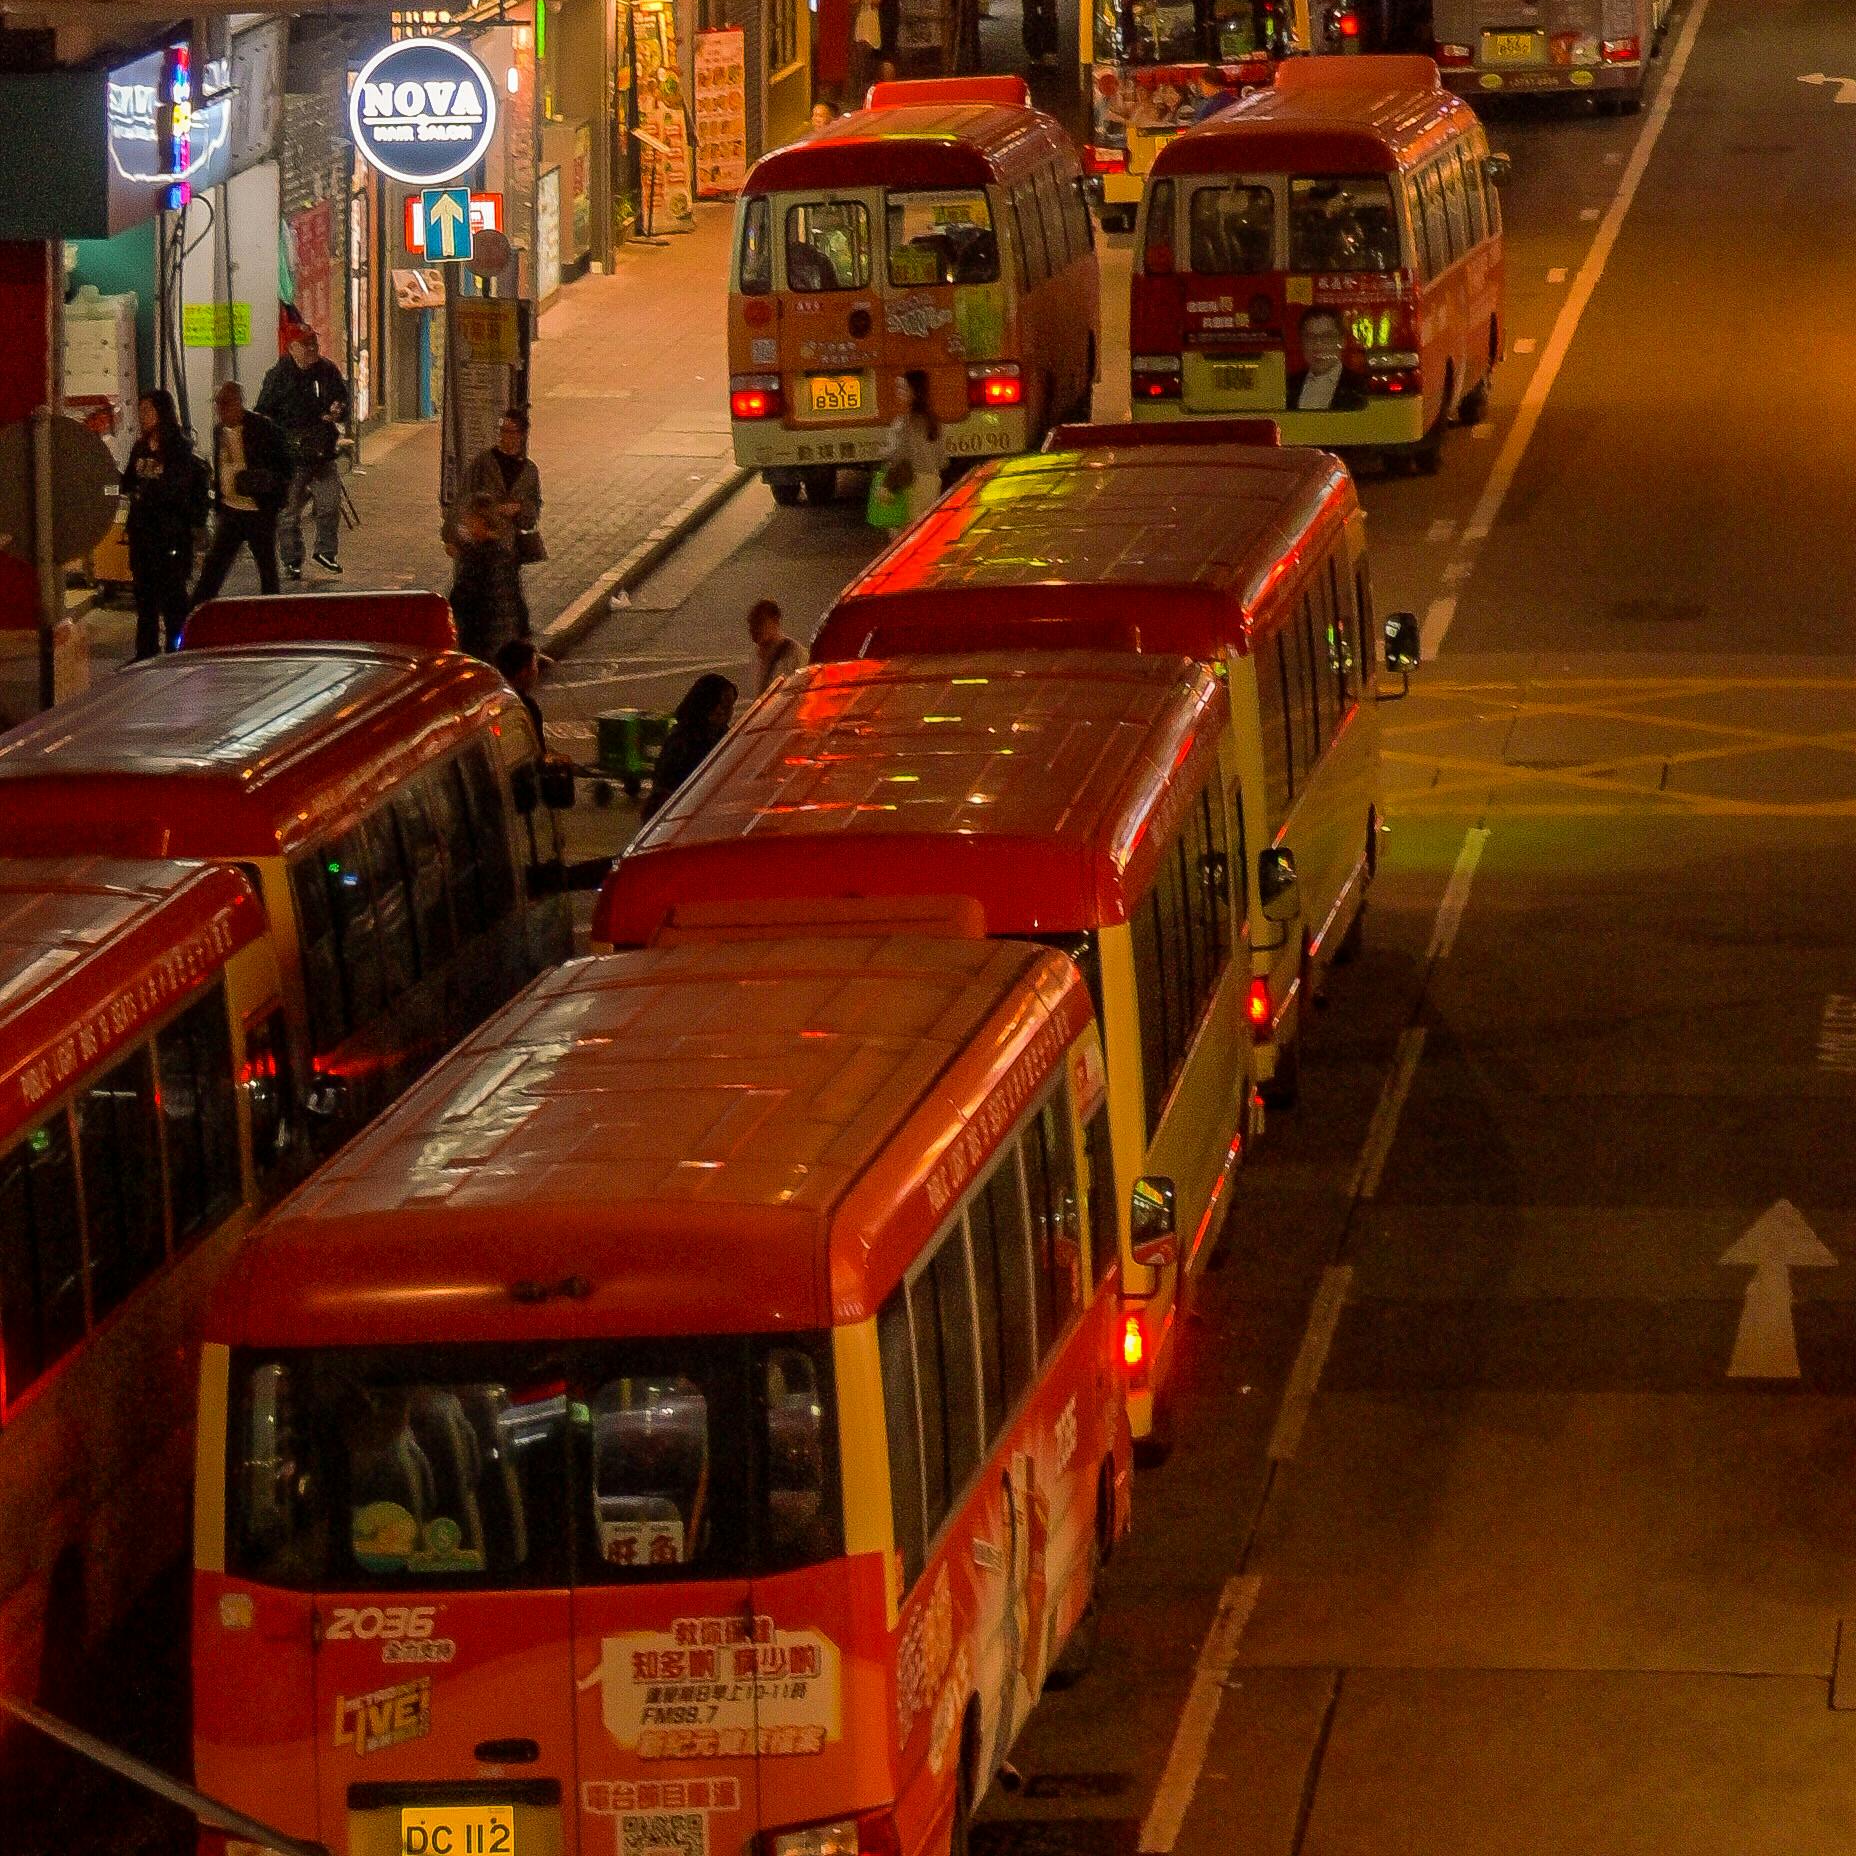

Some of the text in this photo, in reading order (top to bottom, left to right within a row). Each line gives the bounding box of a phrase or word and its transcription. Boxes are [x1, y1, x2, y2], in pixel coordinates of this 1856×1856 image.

[363, 81, 483, 118] NOVA
[373, 124, 473, 143] HAIR SALON
[823, 382, 848, 396] LX
[817, 395, 858, 408] 8915
[406, 1822, 511, 1855] DC 112
